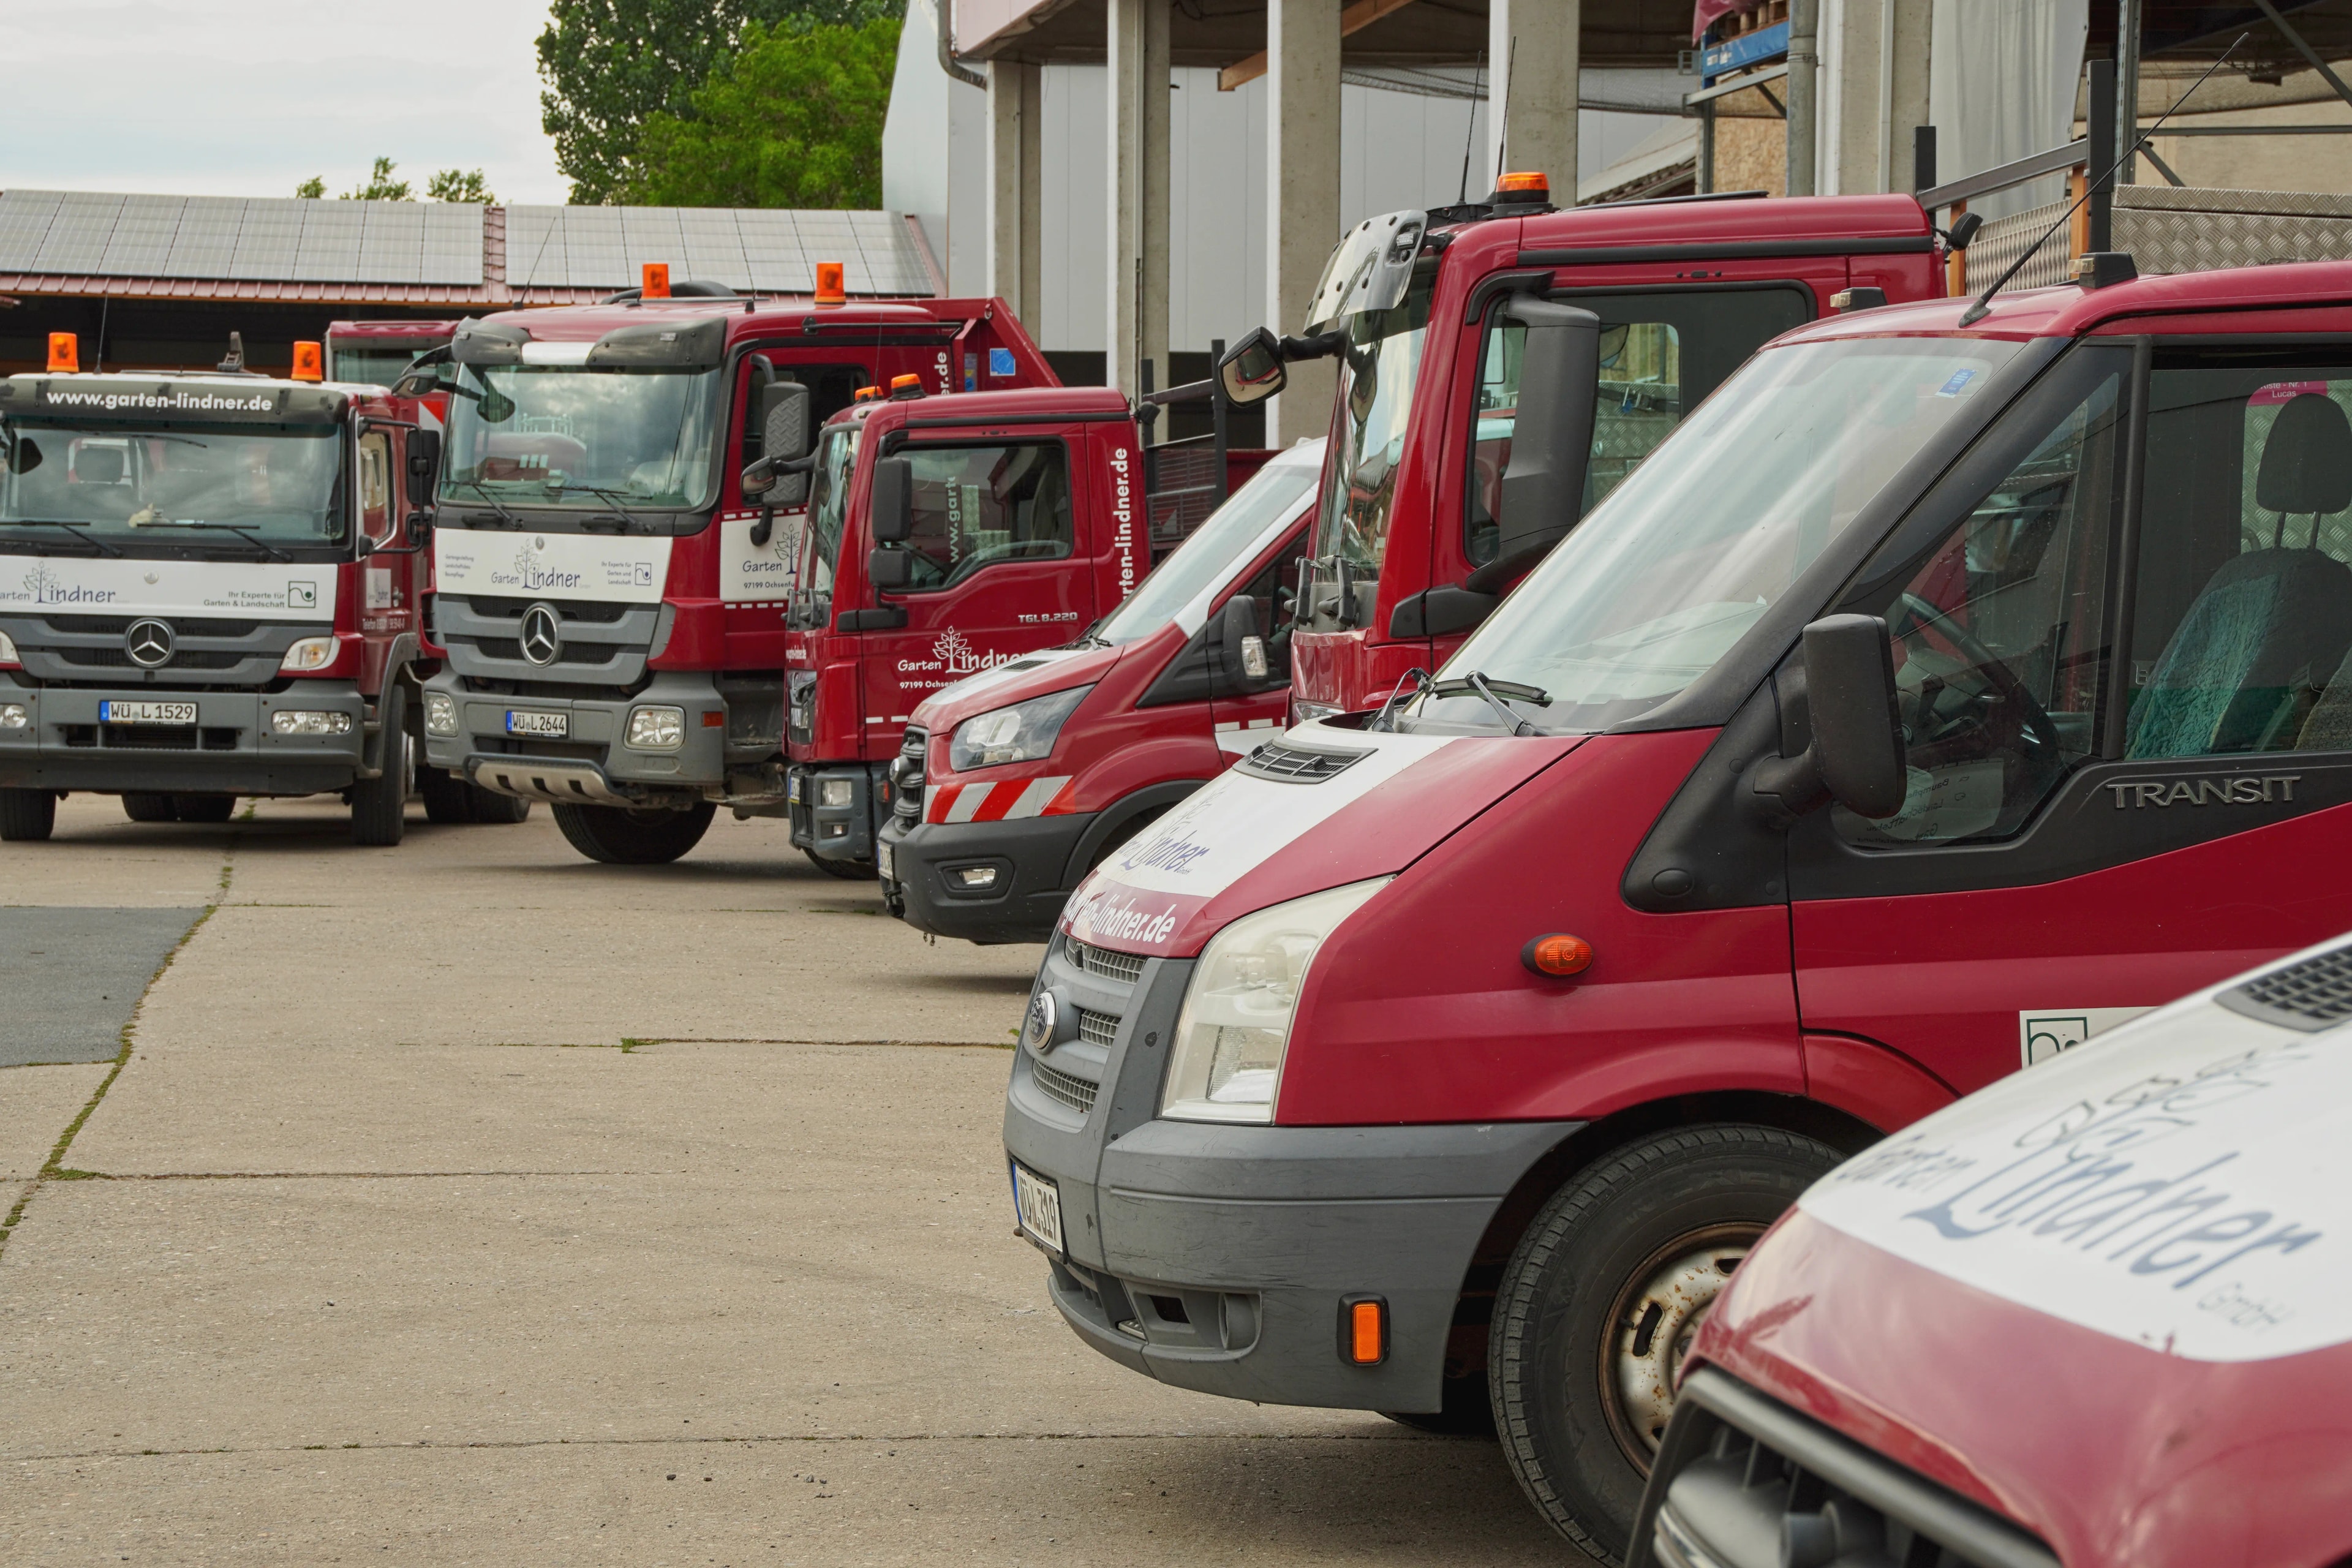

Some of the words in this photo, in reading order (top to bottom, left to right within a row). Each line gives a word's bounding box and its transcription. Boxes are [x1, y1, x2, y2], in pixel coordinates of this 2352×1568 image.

[47, 392, 273, 411] www.garten-lindner.de
[1110, 448, 1133, 600] rten-lindner.de
[742, 560, 782, 572] Garten
[491, 572, 519, 584] Garten
[522, 567, 581, 590] Lindner
[34, 584, 116, 605] Lindner
[1018, 614, 1040, 623] TGL
[1041, 612, 1078, 622] 8.220
[898, 659, 941, 671] Garten
[111, 704, 130, 718] WÜ
[142, 705, 151, 718] L
[155, 705, 193, 720] 1529
[513, 714, 524, 729] WÜ
[531, 715, 537, 730] L
[540, 716, 565, 732] 2644
[2105, 775, 2302, 809] TRANSIT
[1036, 1185, 1058, 1244] 319
[1899, 1150, 2322, 1291] Lindner
